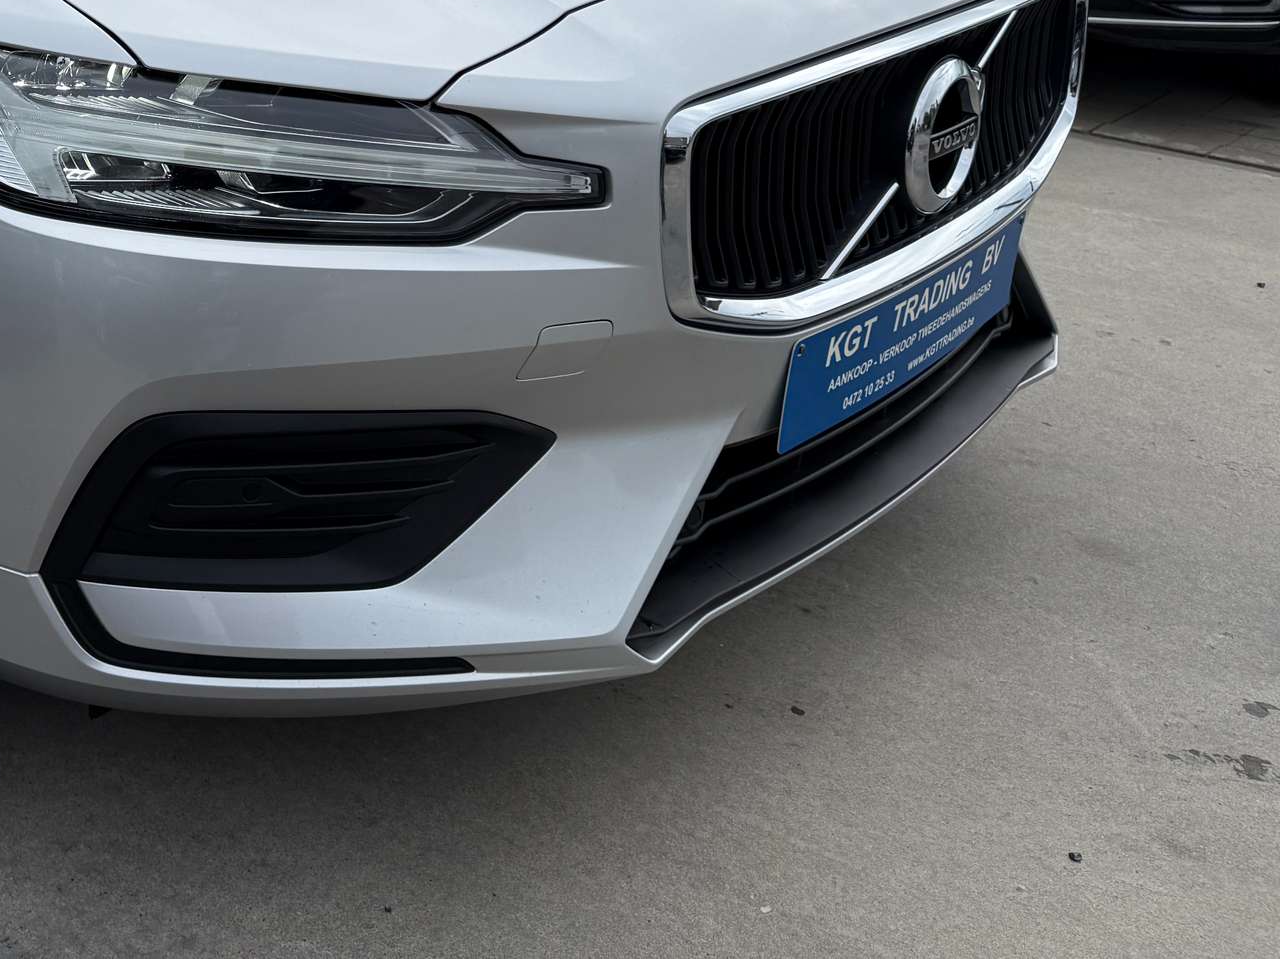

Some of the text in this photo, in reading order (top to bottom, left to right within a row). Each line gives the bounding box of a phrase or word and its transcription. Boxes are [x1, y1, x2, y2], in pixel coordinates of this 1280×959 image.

[931, 122, 976, 154] VOLVO
[825, 235, 1005, 368] KGT TRADING BV
[827, 359, 873, 392] AANKOOP
[879, 335, 917, 365] VERKOOP
[917, 279, 992, 341] TWEEDEHANDSWAGENS
[842, 316, 976, 410] 0472 10 25 33 www.KGTTRADING.be
